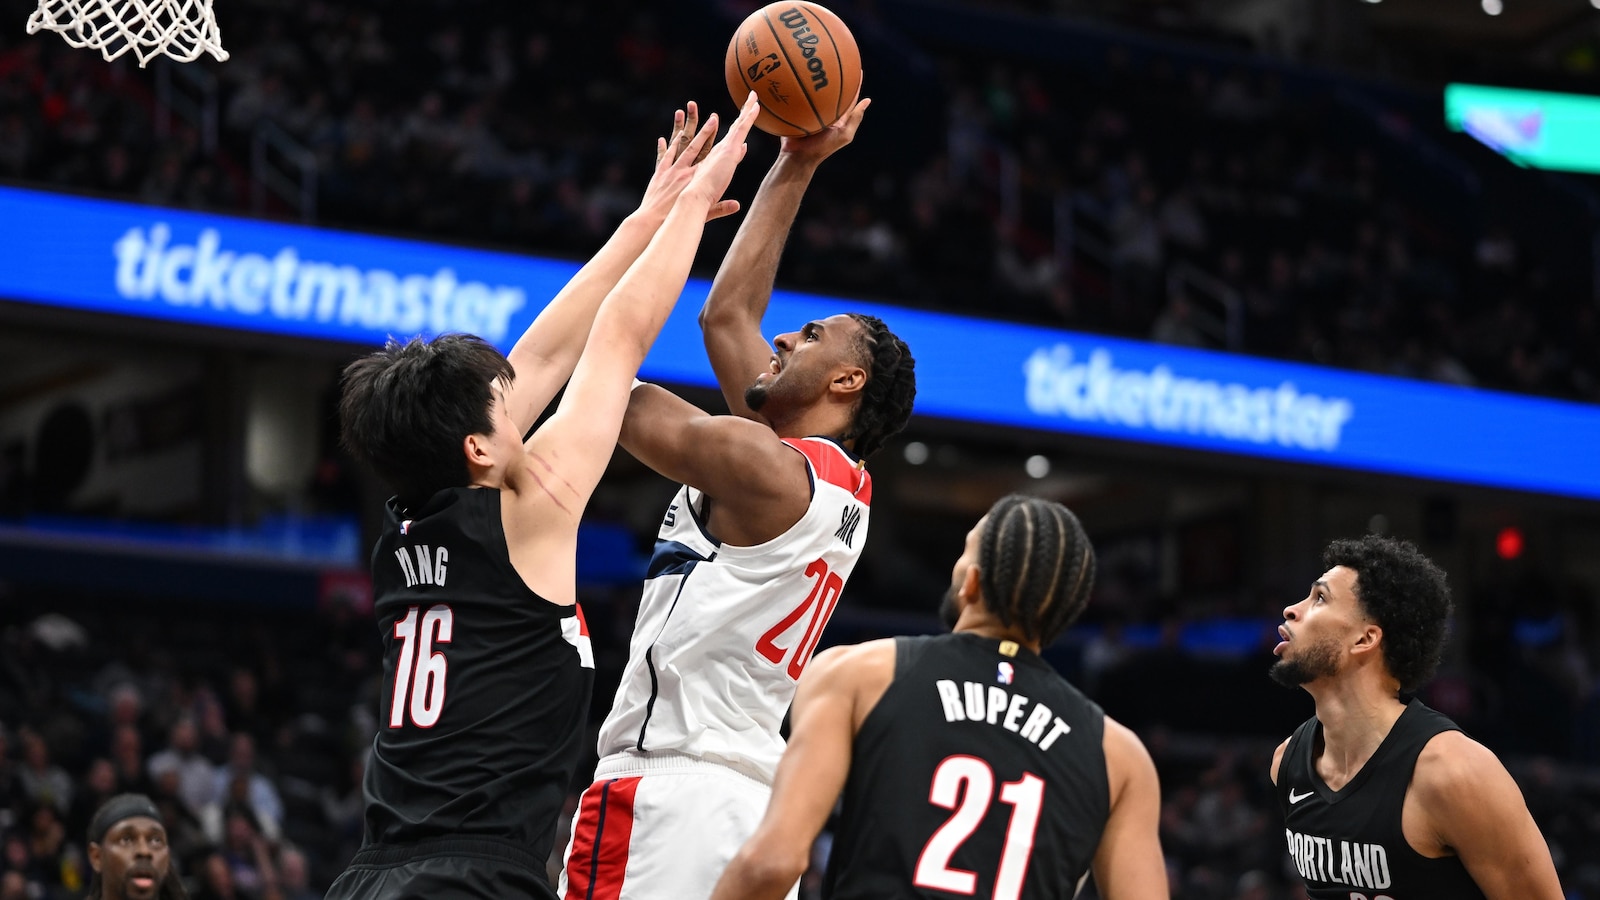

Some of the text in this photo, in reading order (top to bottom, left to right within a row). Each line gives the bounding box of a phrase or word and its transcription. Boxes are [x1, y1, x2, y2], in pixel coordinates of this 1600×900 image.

[779, 7, 829, 92] Wilson
[114, 222, 526, 342] ticketmaster
[1024, 343, 1354, 451] ticketmaster
[389, 604, 454, 729] 16
[755, 557, 843, 681] 20
[936, 679, 1071, 751] RUPERT
[913, 753, 1046, 900] 21
[1286, 828, 1391, 890] PORTLAND
